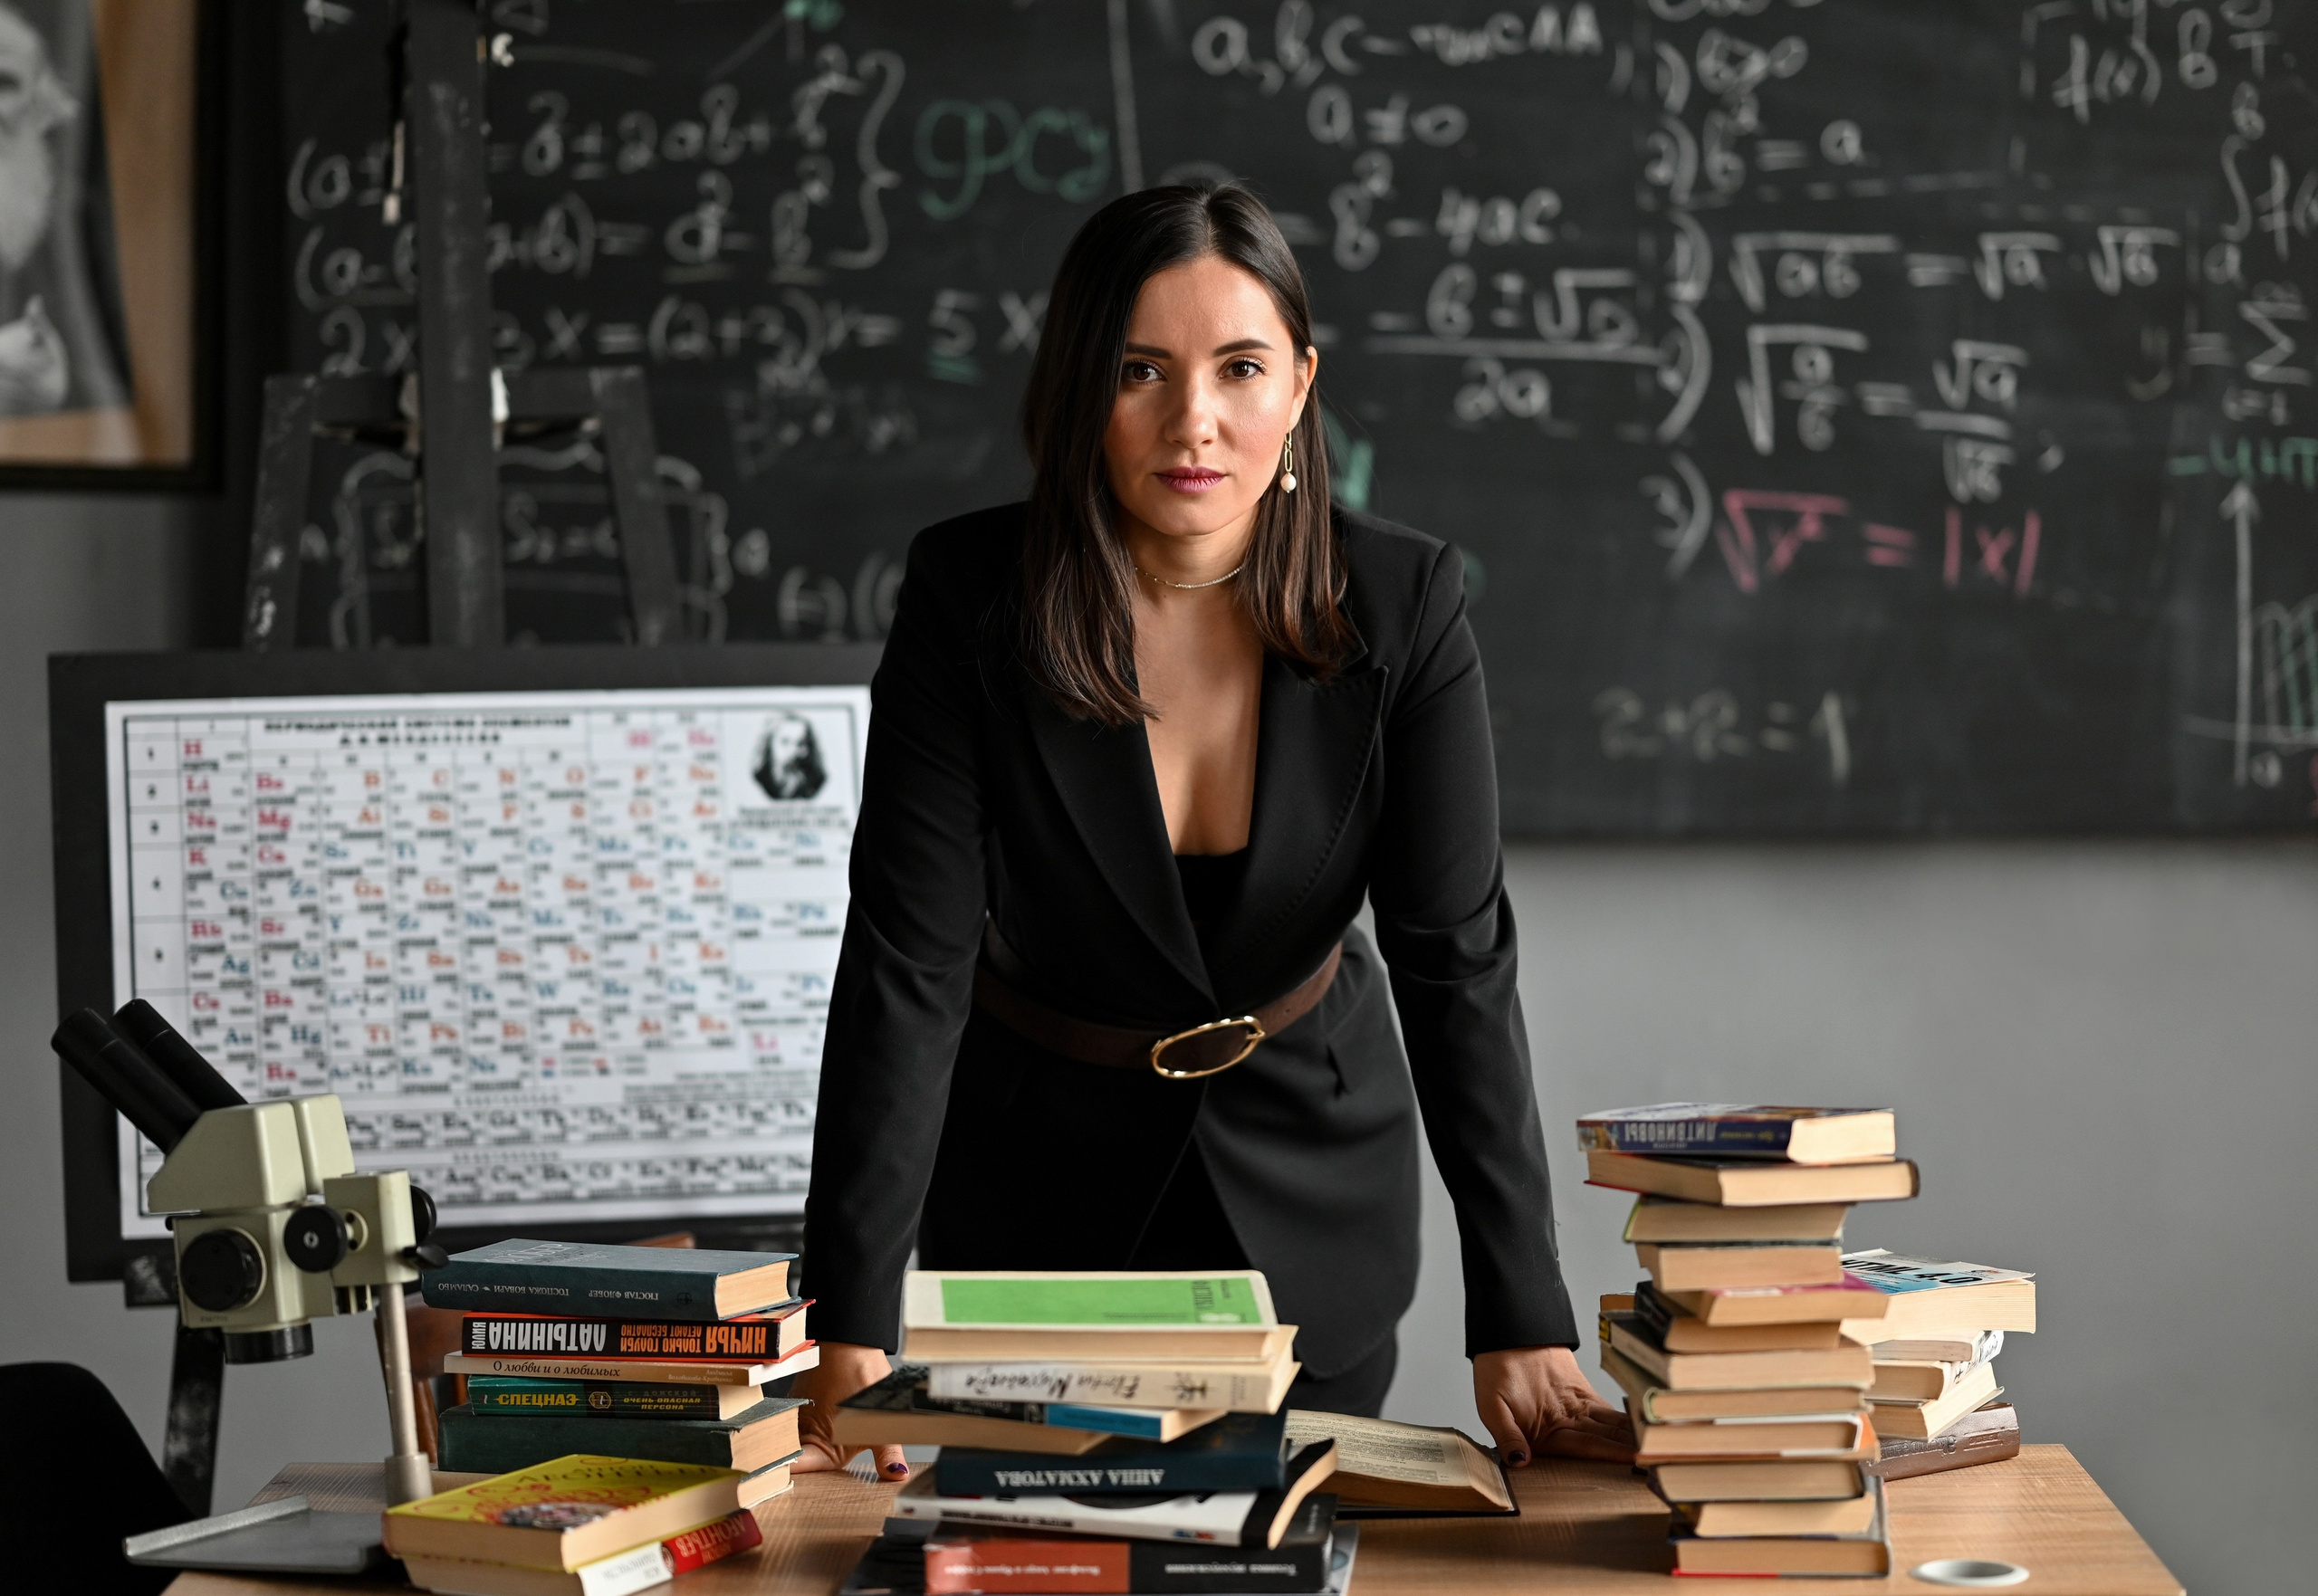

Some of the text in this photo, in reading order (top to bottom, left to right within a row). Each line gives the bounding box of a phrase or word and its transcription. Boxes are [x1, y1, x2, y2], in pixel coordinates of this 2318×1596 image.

[437, 1282, 660, 1302] ГЮСТАВ ФЛОБЕР ГОСПОЖА БОВАРИ САЛАМБО
[471, 1321, 486, 1350] ЮЛИЯ
[488, 1322, 607, 1352] ЛАТЫНИНА
[620, 1324, 704, 1339] ЛЕТАЮТ БЕСПЛАТНО
[705, 1325, 767, 1354] НИЧЬЯ
[619, 1336, 703, 1353] ТОЛЬКО ГОЛУБИ
[493, 1361, 620, 1377] О любви и о любимых
[496, 1392, 578, 1408] СПЕЦНАЗ
[994, 1468, 1164, 1488] АННА АХМАТОВА
